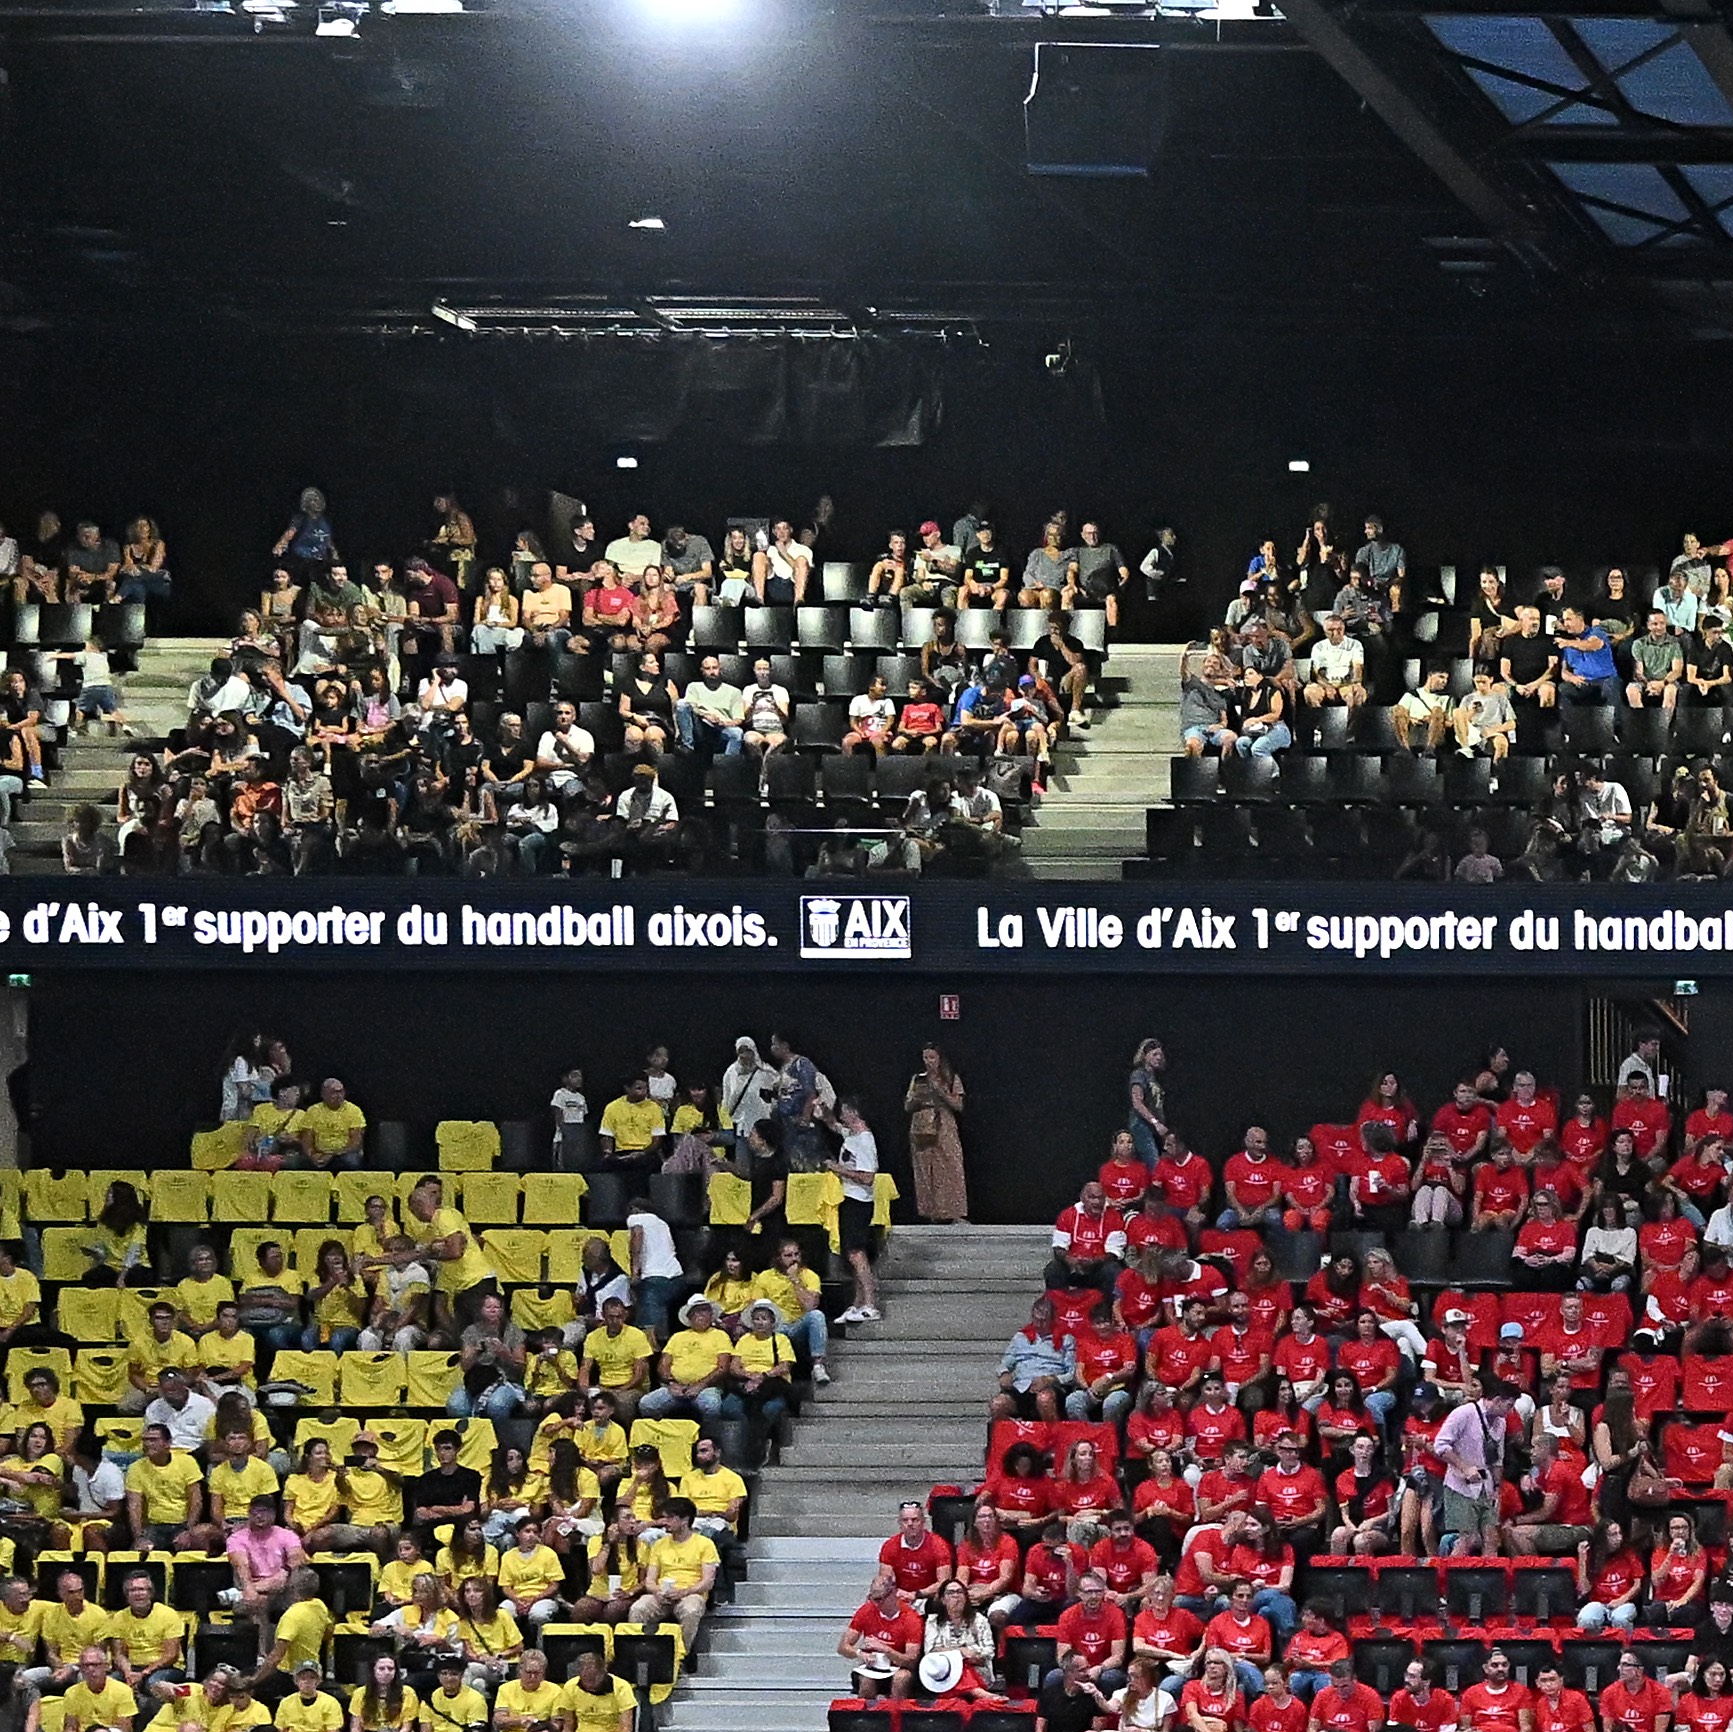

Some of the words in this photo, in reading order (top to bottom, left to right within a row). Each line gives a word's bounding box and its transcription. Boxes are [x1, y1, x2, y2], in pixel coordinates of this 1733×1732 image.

[23, 902, 124, 943] d'Aix
[194, 906, 385, 953] supporter
[398, 905, 447, 945] du
[462, 905, 634, 946] handball
[648, 905, 777, 946] aixois.
[844, 900, 908, 938] AIX
[978, 907, 1022, 947] La
[1037, 907, 1123, 948] Ville
[1137, 908, 1236, 948] d'Aix
[1307, 911, 1497, 958] supporter
[1510, 910, 1558, 950] du
